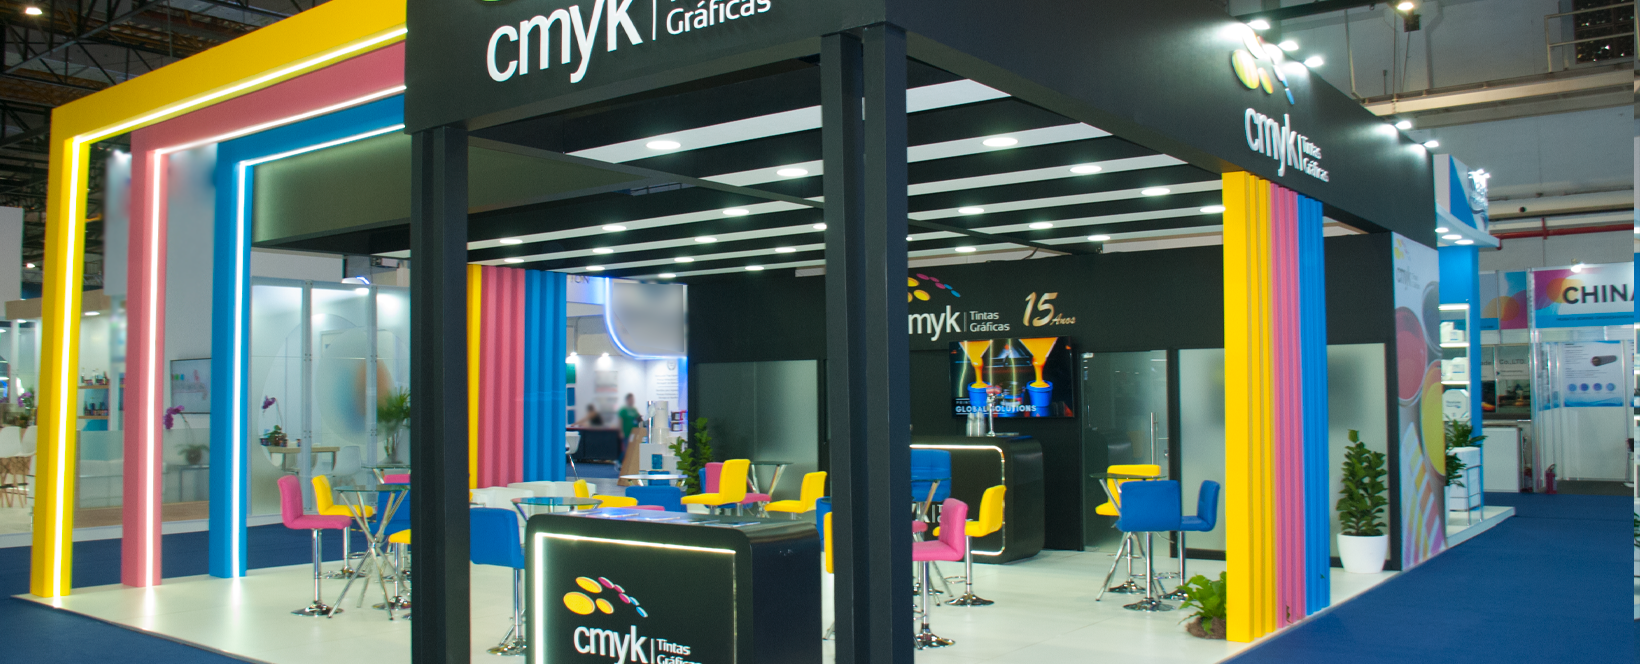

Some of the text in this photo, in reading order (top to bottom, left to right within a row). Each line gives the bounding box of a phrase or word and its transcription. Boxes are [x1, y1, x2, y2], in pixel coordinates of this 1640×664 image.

[666, 0, 772, 35] Gráficas
[486, 0, 643, 83] cmyk
[1244, 107, 1300, 177] cmyk
[1562, 283, 1634, 305] CHIN
[969, 310, 1000, 320] Tintas
[1022, 291, 1058, 327] 15
[1049, 312, 1076, 326] Anos
[907, 305, 962, 342] myk
[969, 322, 1010, 332] Gráficas
[955, 405, 987, 413] GLOBAL
[573, 624, 648, 664] cmyk
[656, 637, 691, 656] Tintas
[656, 653, 703, 664] Gráf
